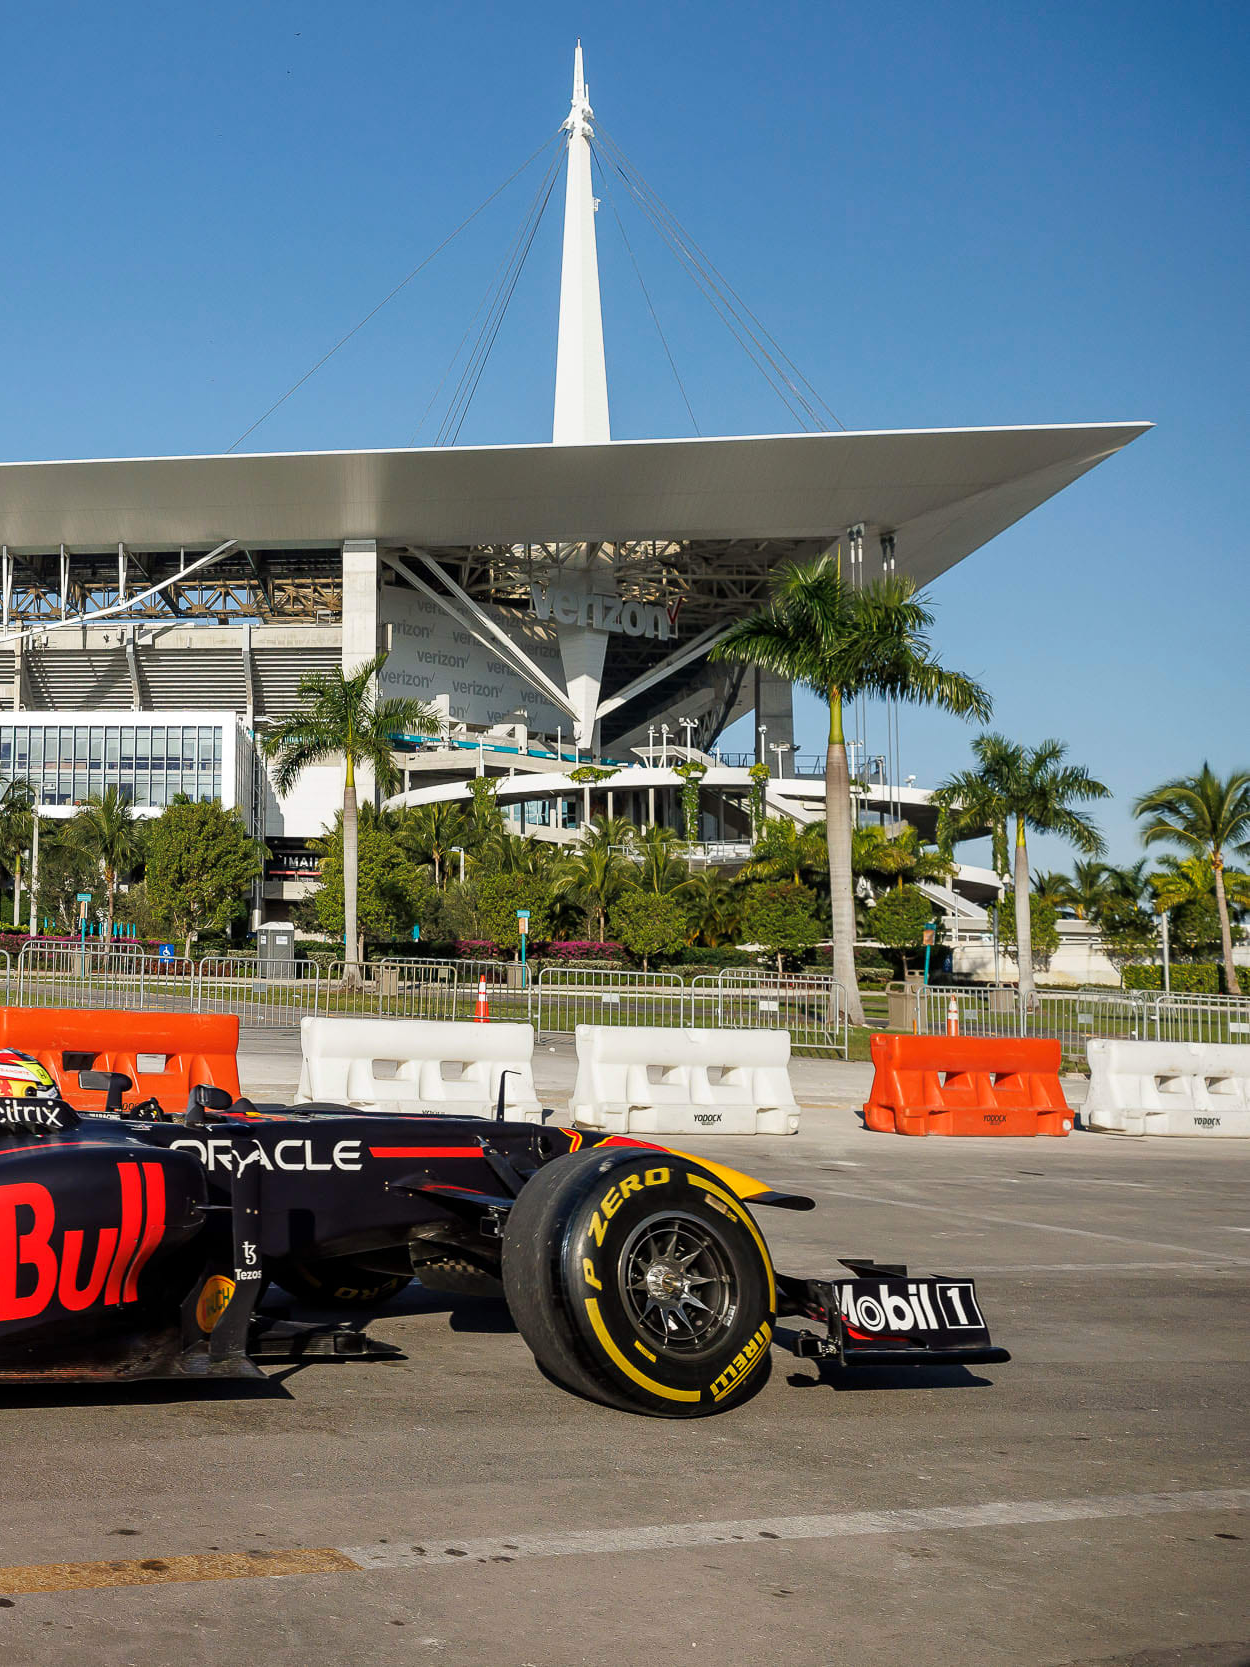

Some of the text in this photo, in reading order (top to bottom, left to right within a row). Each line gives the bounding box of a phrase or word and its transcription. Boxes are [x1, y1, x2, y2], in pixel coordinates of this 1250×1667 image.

[417, 649, 464, 669] verizon
[381, 670, 429, 688] verizon
[452, 680, 499, 698] verizon
[694, 1113, 723, 1122] YODOCK
[1194, 1117, 1221, 1126] YODOCK
[582, 1167, 671, 1292] P ZERO
[234, 1269, 262, 1280] Tezos
[835, 1284, 969, 1331] Mobil 1
[709, 1321, 772, 1402] PIRELLI
